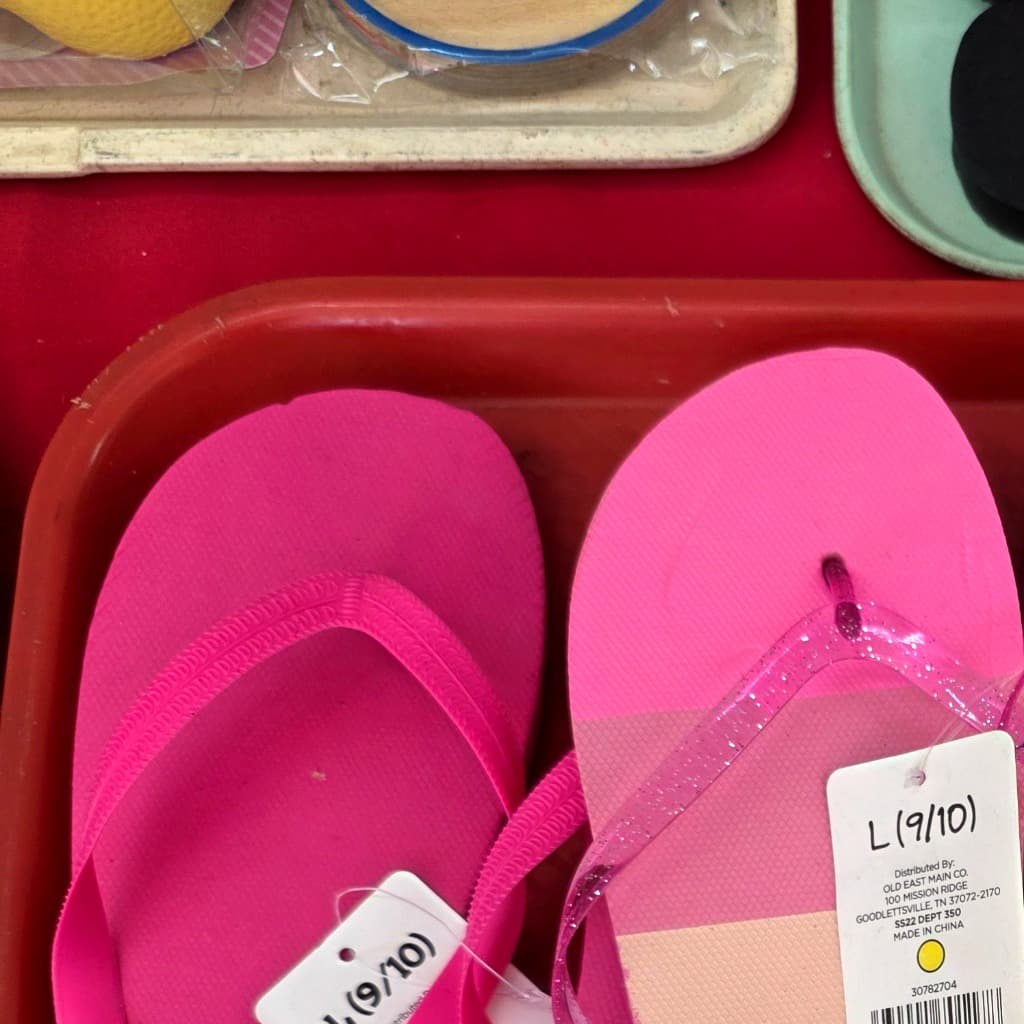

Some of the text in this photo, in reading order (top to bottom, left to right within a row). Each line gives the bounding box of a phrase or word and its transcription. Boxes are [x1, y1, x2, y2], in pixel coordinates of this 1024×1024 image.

[868, 795, 976, 851] L (9/10)
[883, 868, 969, 894] OLD EAST MAIN CO.
[895, 859, 956, 879] Distributed By:
[856, 886, 1001, 925] GOODLETTSVILLE, TN 37072-2170
[885, 881, 969, 906] 100 MISSION RIDGE
[893, 920, 965, 942] MADE IN CHINA
[894, 908, 962, 929] SS22 DEPT 350
[346, 932, 437, 1016] (9/10)
[911, 980, 958, 998] 30782704
